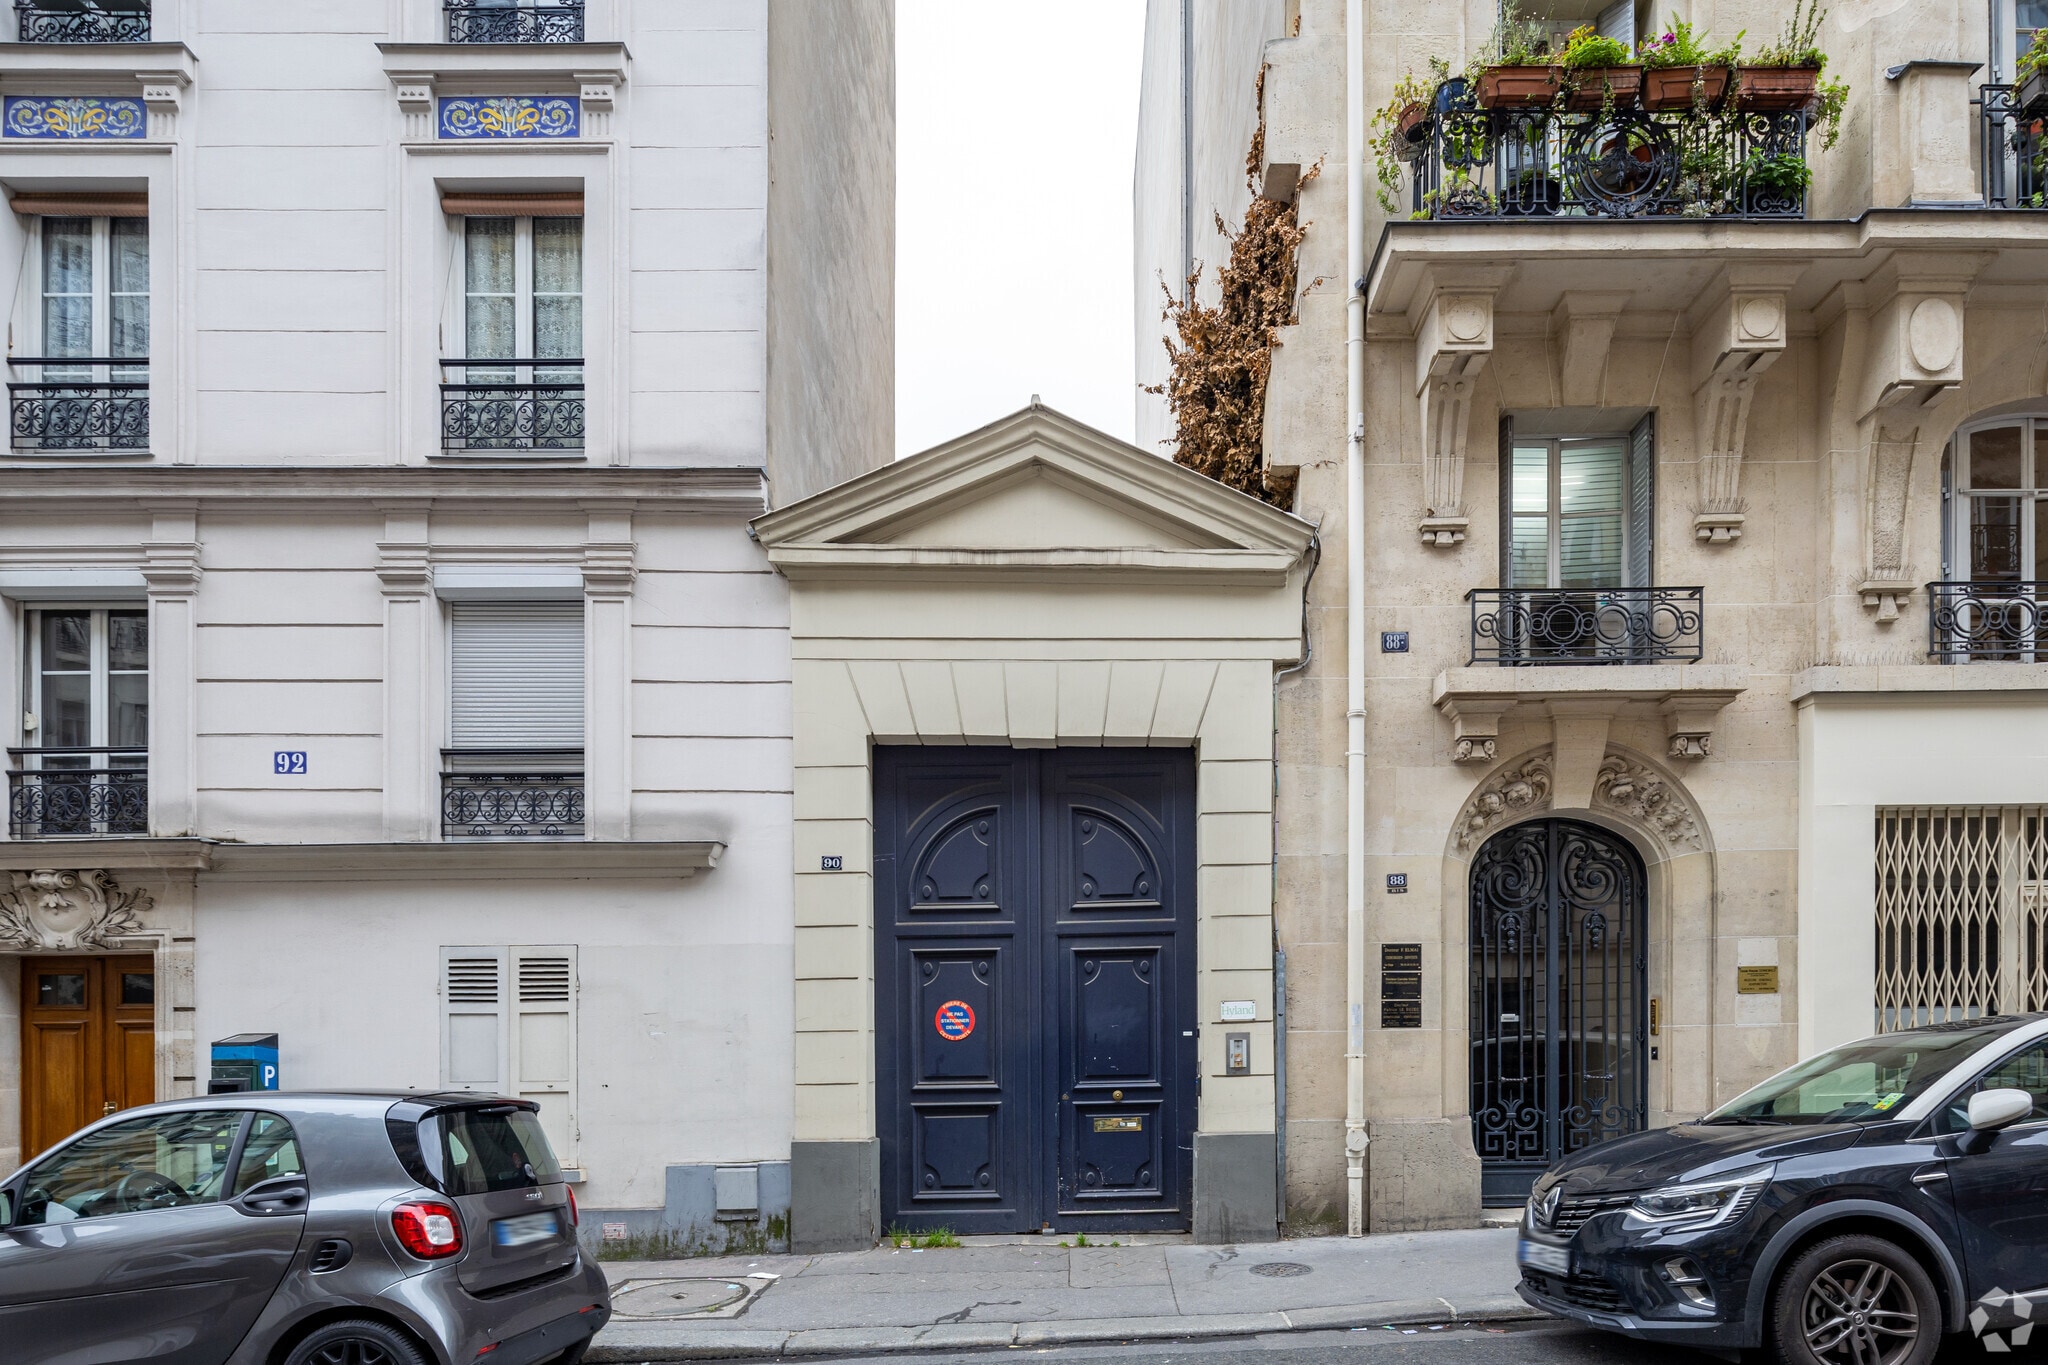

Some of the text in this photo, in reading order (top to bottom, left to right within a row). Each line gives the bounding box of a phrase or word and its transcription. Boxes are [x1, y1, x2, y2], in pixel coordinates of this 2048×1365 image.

[1386, 634, 1400, 649] 88
[277, 753, 304, 773] 92
[824, 858, 840, 868] 90
[1390, 875, 1404, 885] 88
[1221, 1005, 1254, 1016] Hyland
[264, 1065, 275, 1087] P
